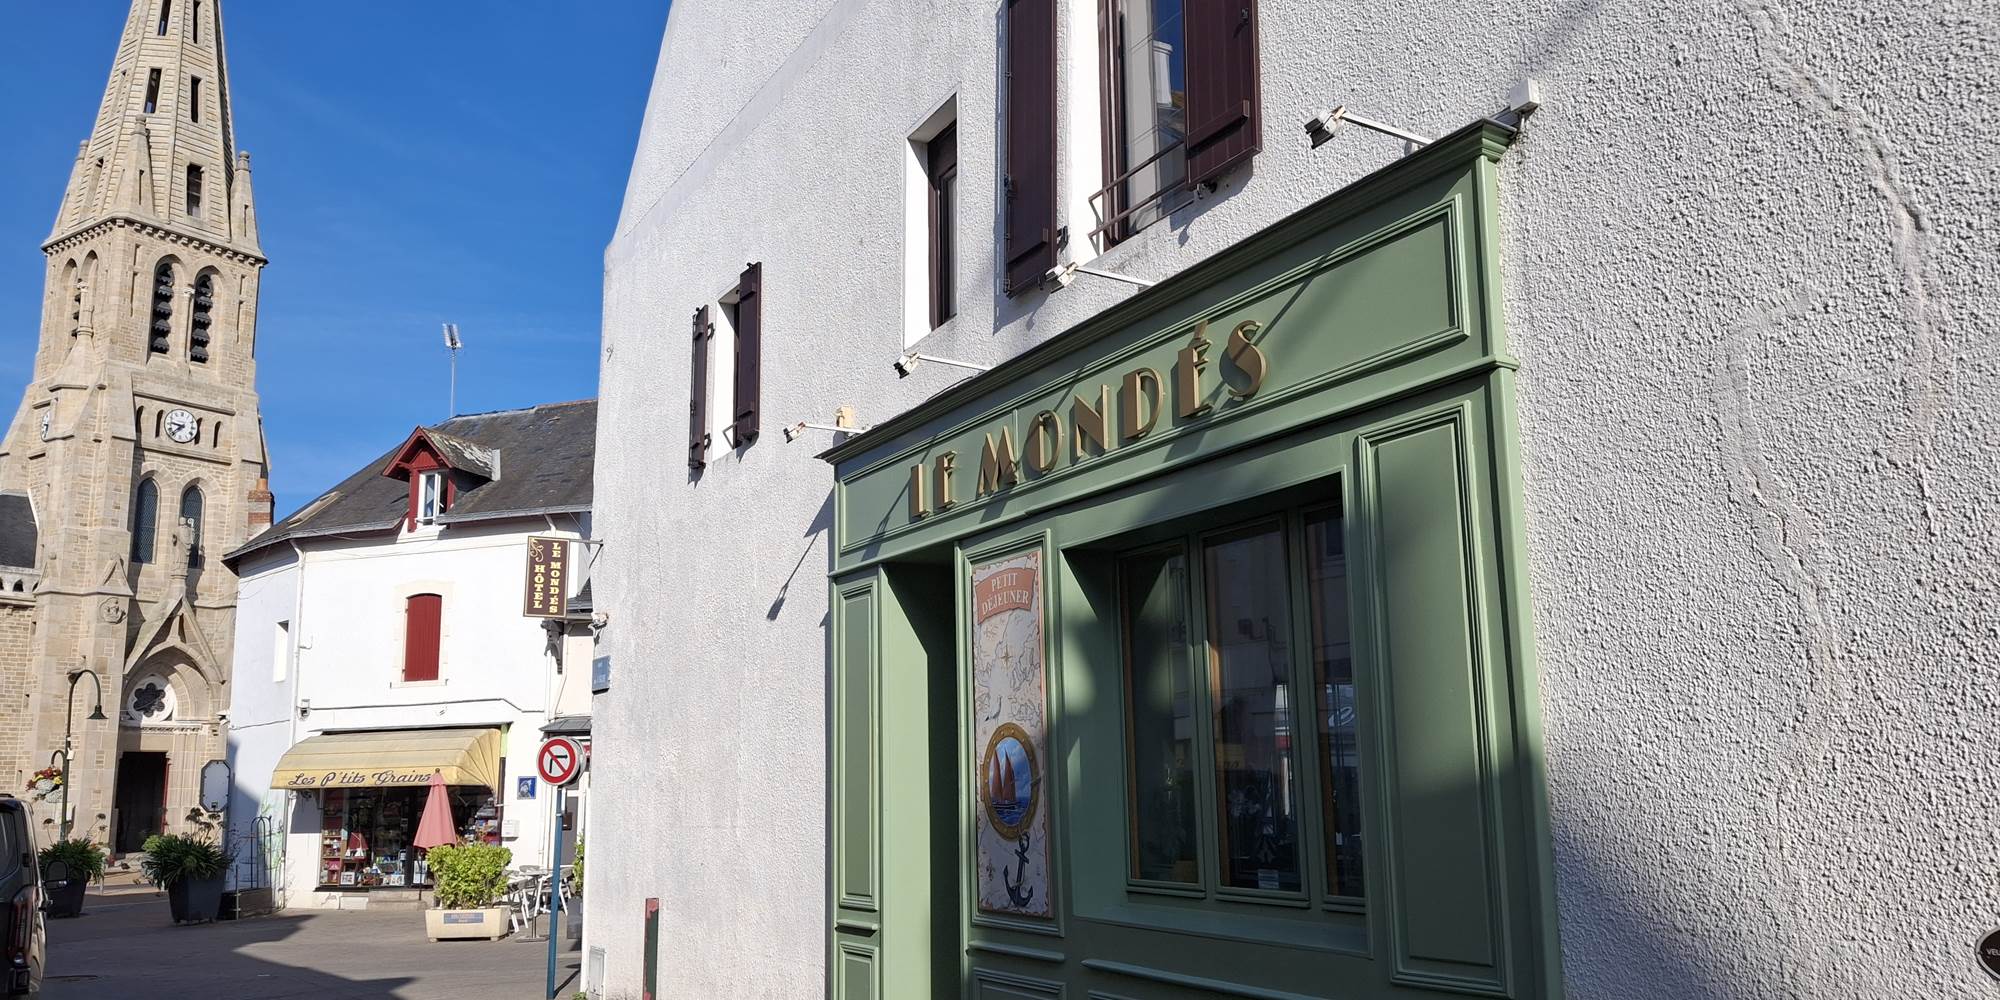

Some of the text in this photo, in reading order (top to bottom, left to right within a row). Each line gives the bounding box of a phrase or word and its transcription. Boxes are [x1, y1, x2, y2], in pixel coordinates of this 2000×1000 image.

[910, 319, 1268, 518] LE MONDÉS
[533, 564, 546, 609] HÔTEL
[549, 542, 562, 614] LE MONDÉS
[991, 572, 1018, 592] PETIT
[982, 590, 1029, 616] DÉJEUNER
[288, 769, 431, 787] Les P'tits Grains
